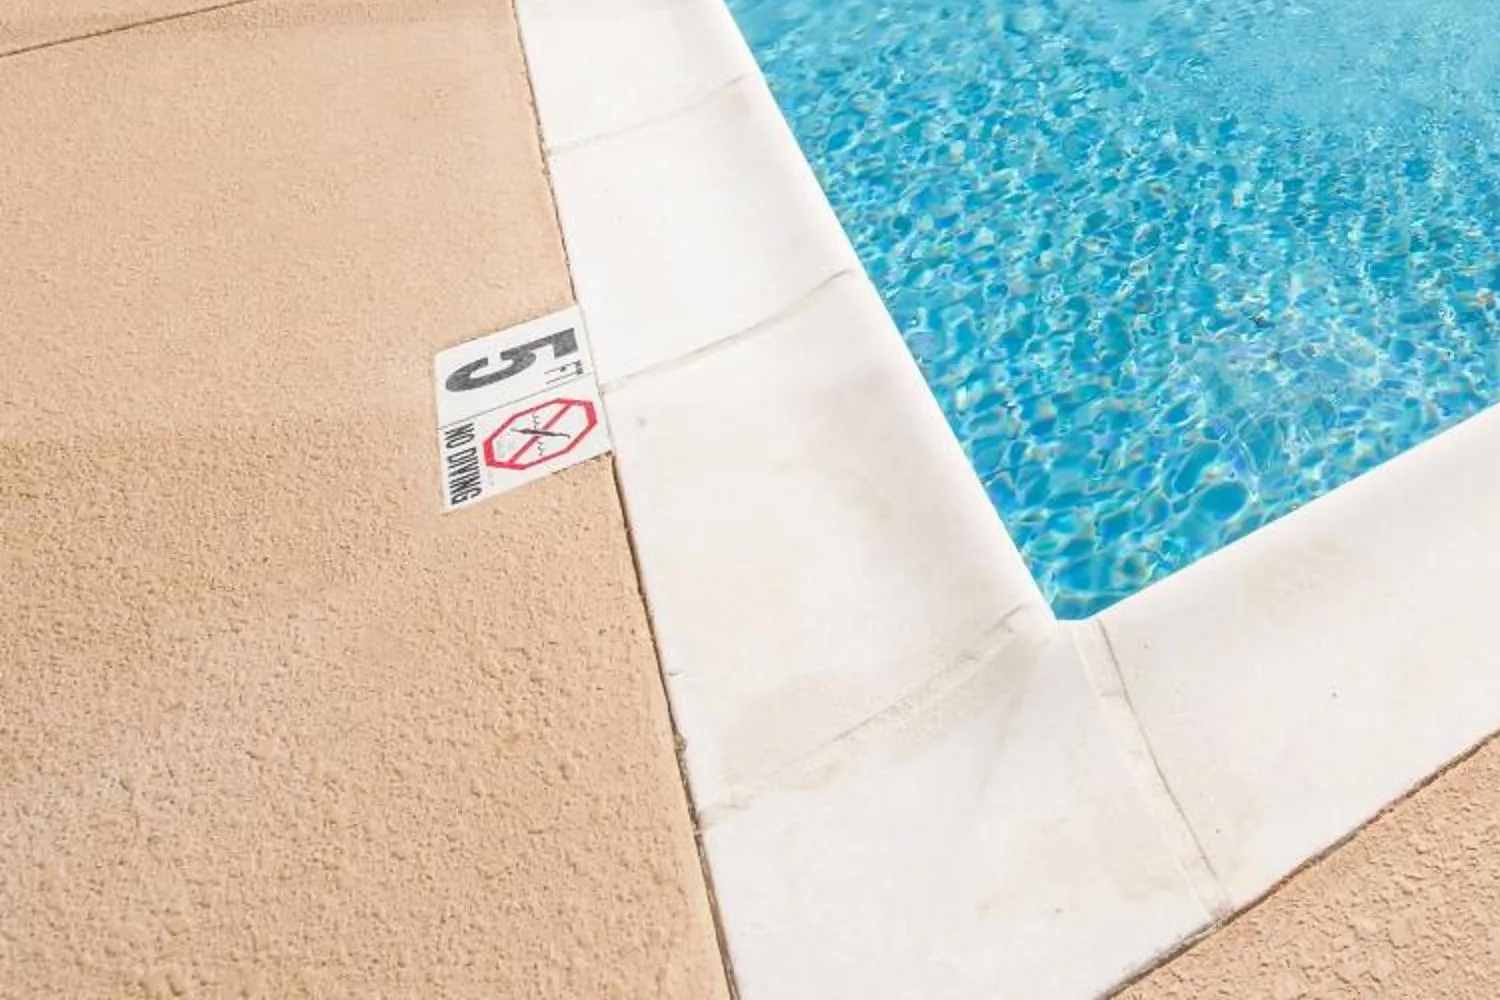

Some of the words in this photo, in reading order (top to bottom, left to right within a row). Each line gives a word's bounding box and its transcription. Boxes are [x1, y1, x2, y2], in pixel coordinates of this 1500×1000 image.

[445, 327, 579, 393] 5
[445, 422, 475, 449] NO
[447, 447, 482, 505] DIVING
